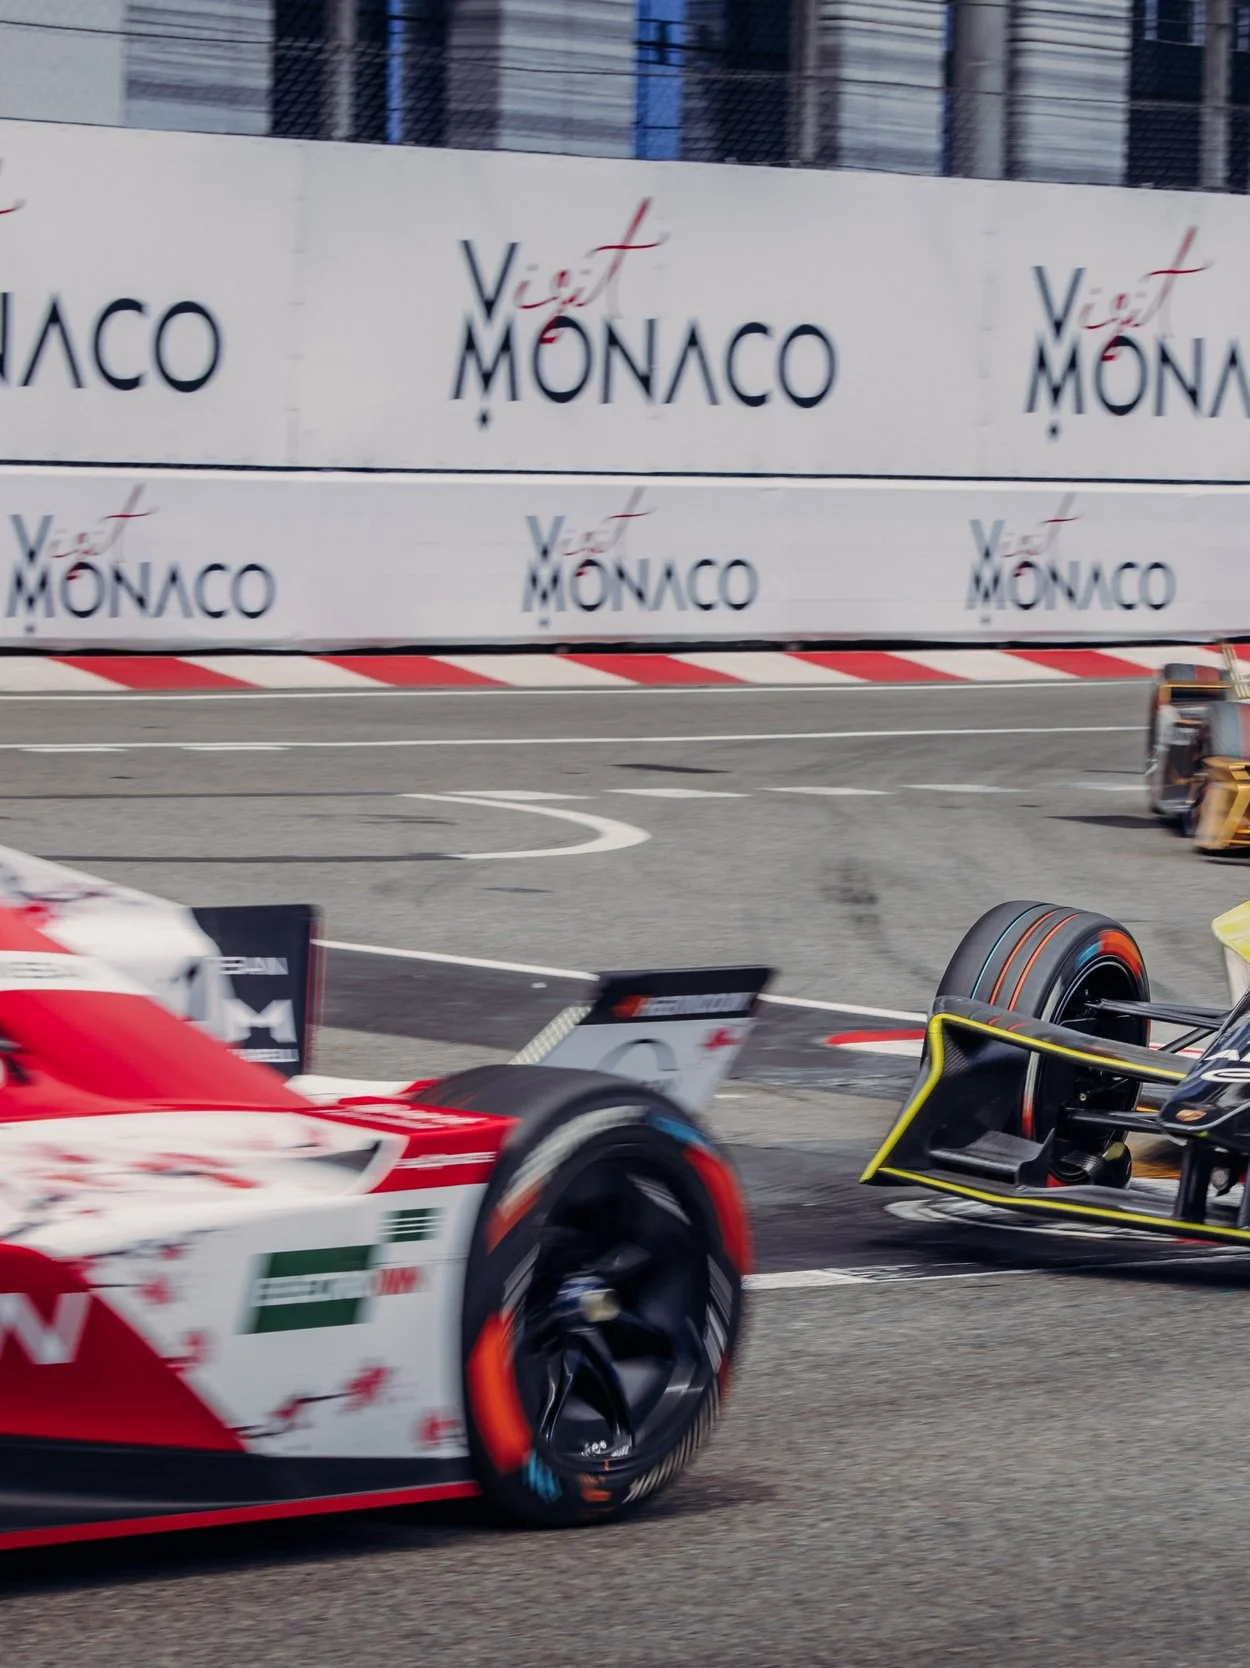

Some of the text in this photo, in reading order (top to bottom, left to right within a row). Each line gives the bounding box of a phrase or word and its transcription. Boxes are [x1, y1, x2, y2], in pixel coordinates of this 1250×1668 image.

[459, 196, 670, 343] Visit
[1031, 225, 1215, 361] Visit
[0, 292, 223, 393] ACO
[449, 312, 838, 408] MONACO
[8, 483, 161, 581] Visit
[4, 561, 277, 620] MONACO
[521, 558, 760, 612] MONACO
[964, 560, 1178, 611] MONACO
